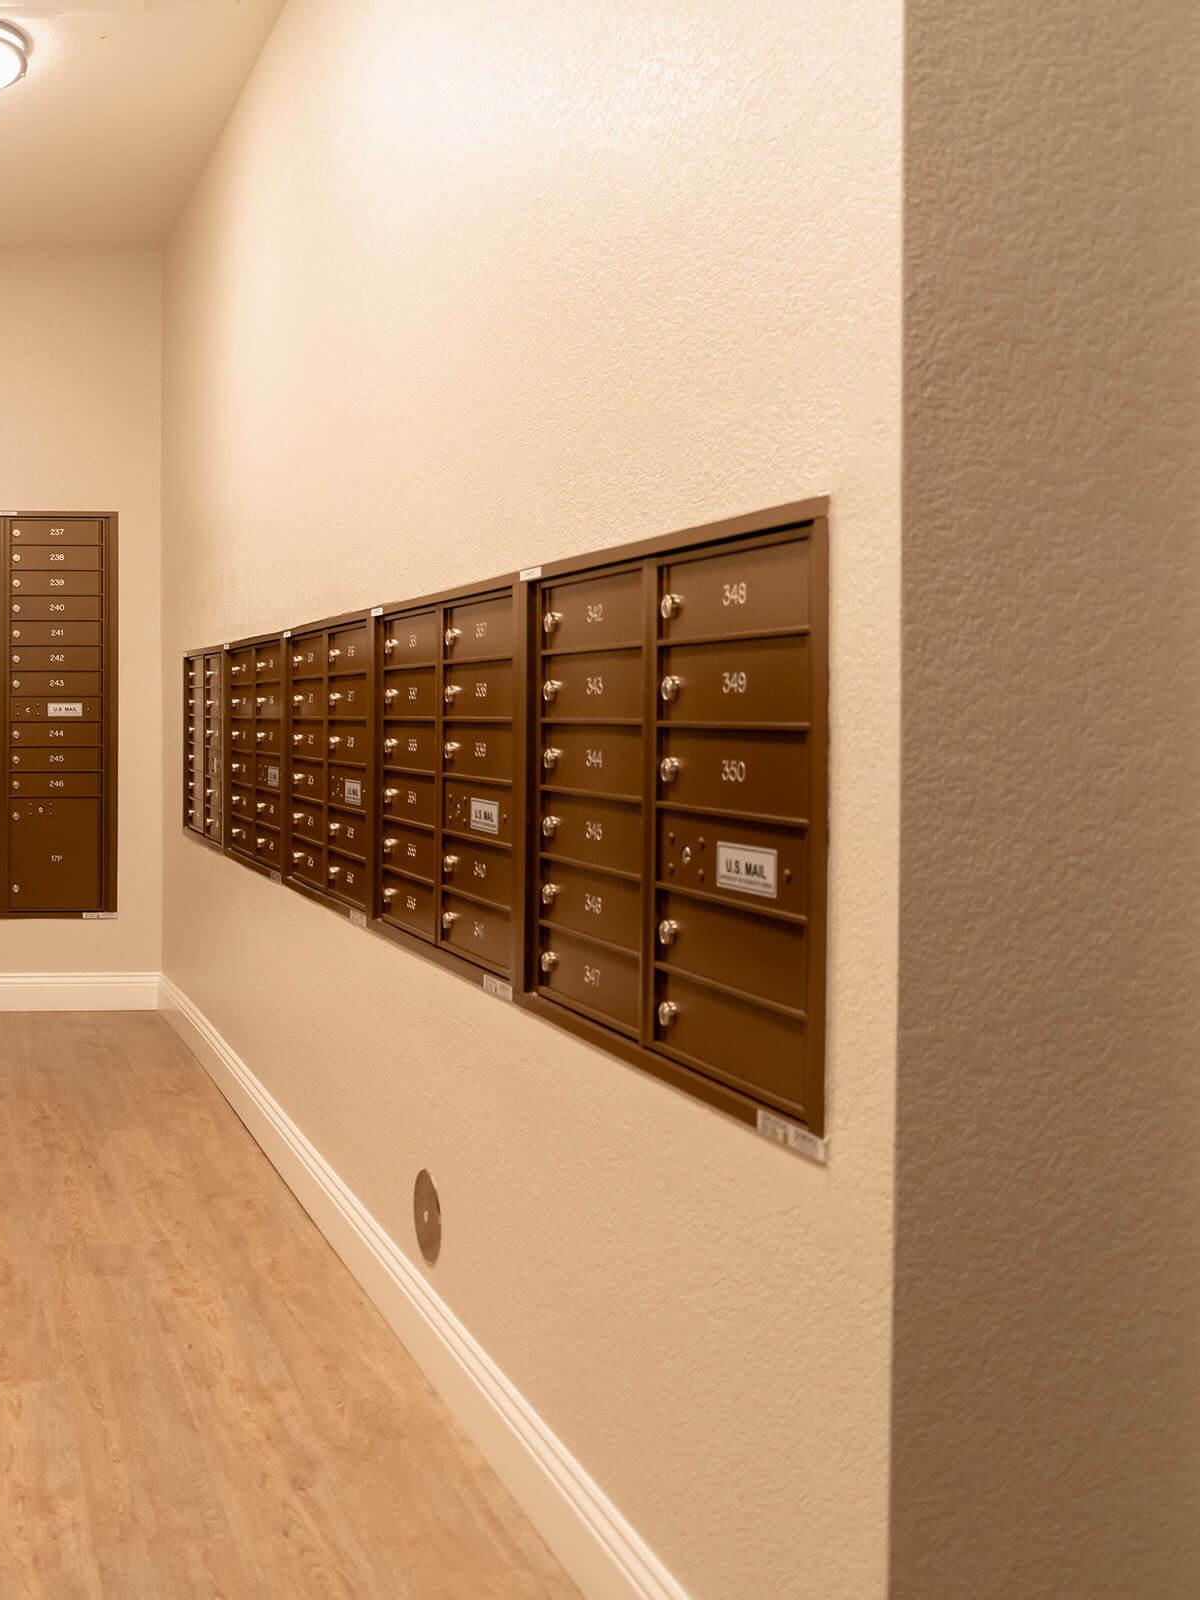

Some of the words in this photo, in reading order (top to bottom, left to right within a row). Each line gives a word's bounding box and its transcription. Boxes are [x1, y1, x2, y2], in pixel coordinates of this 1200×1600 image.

[49, 528, 65, 536] 237
[722, 581, 747, 607] 348
[49, 603, 65, 612] 240
[586, 603, 604, 624] 342
[50, 629, 64, 637] 241
[49, 654, 65, 662] 242
[49, 679, 65, 687] 243
[586, 676, 604, 695] 343
[722, 671, 747, 694] 349
[48, 729, 64, 738] 244
[48, 754, 65, 763] 245
[585, 749, 603, 768] 344
[721, 759, 746, 783] 350
[48, 779, 65, 788] 246
[483, 811, 494, 823] MAIL
[585, 821, 603, 841] 345
[725, 859, 743, 875] U.S.
[744, 861, 767, 880] MAIL
[583, 964, 601, 987] 347
